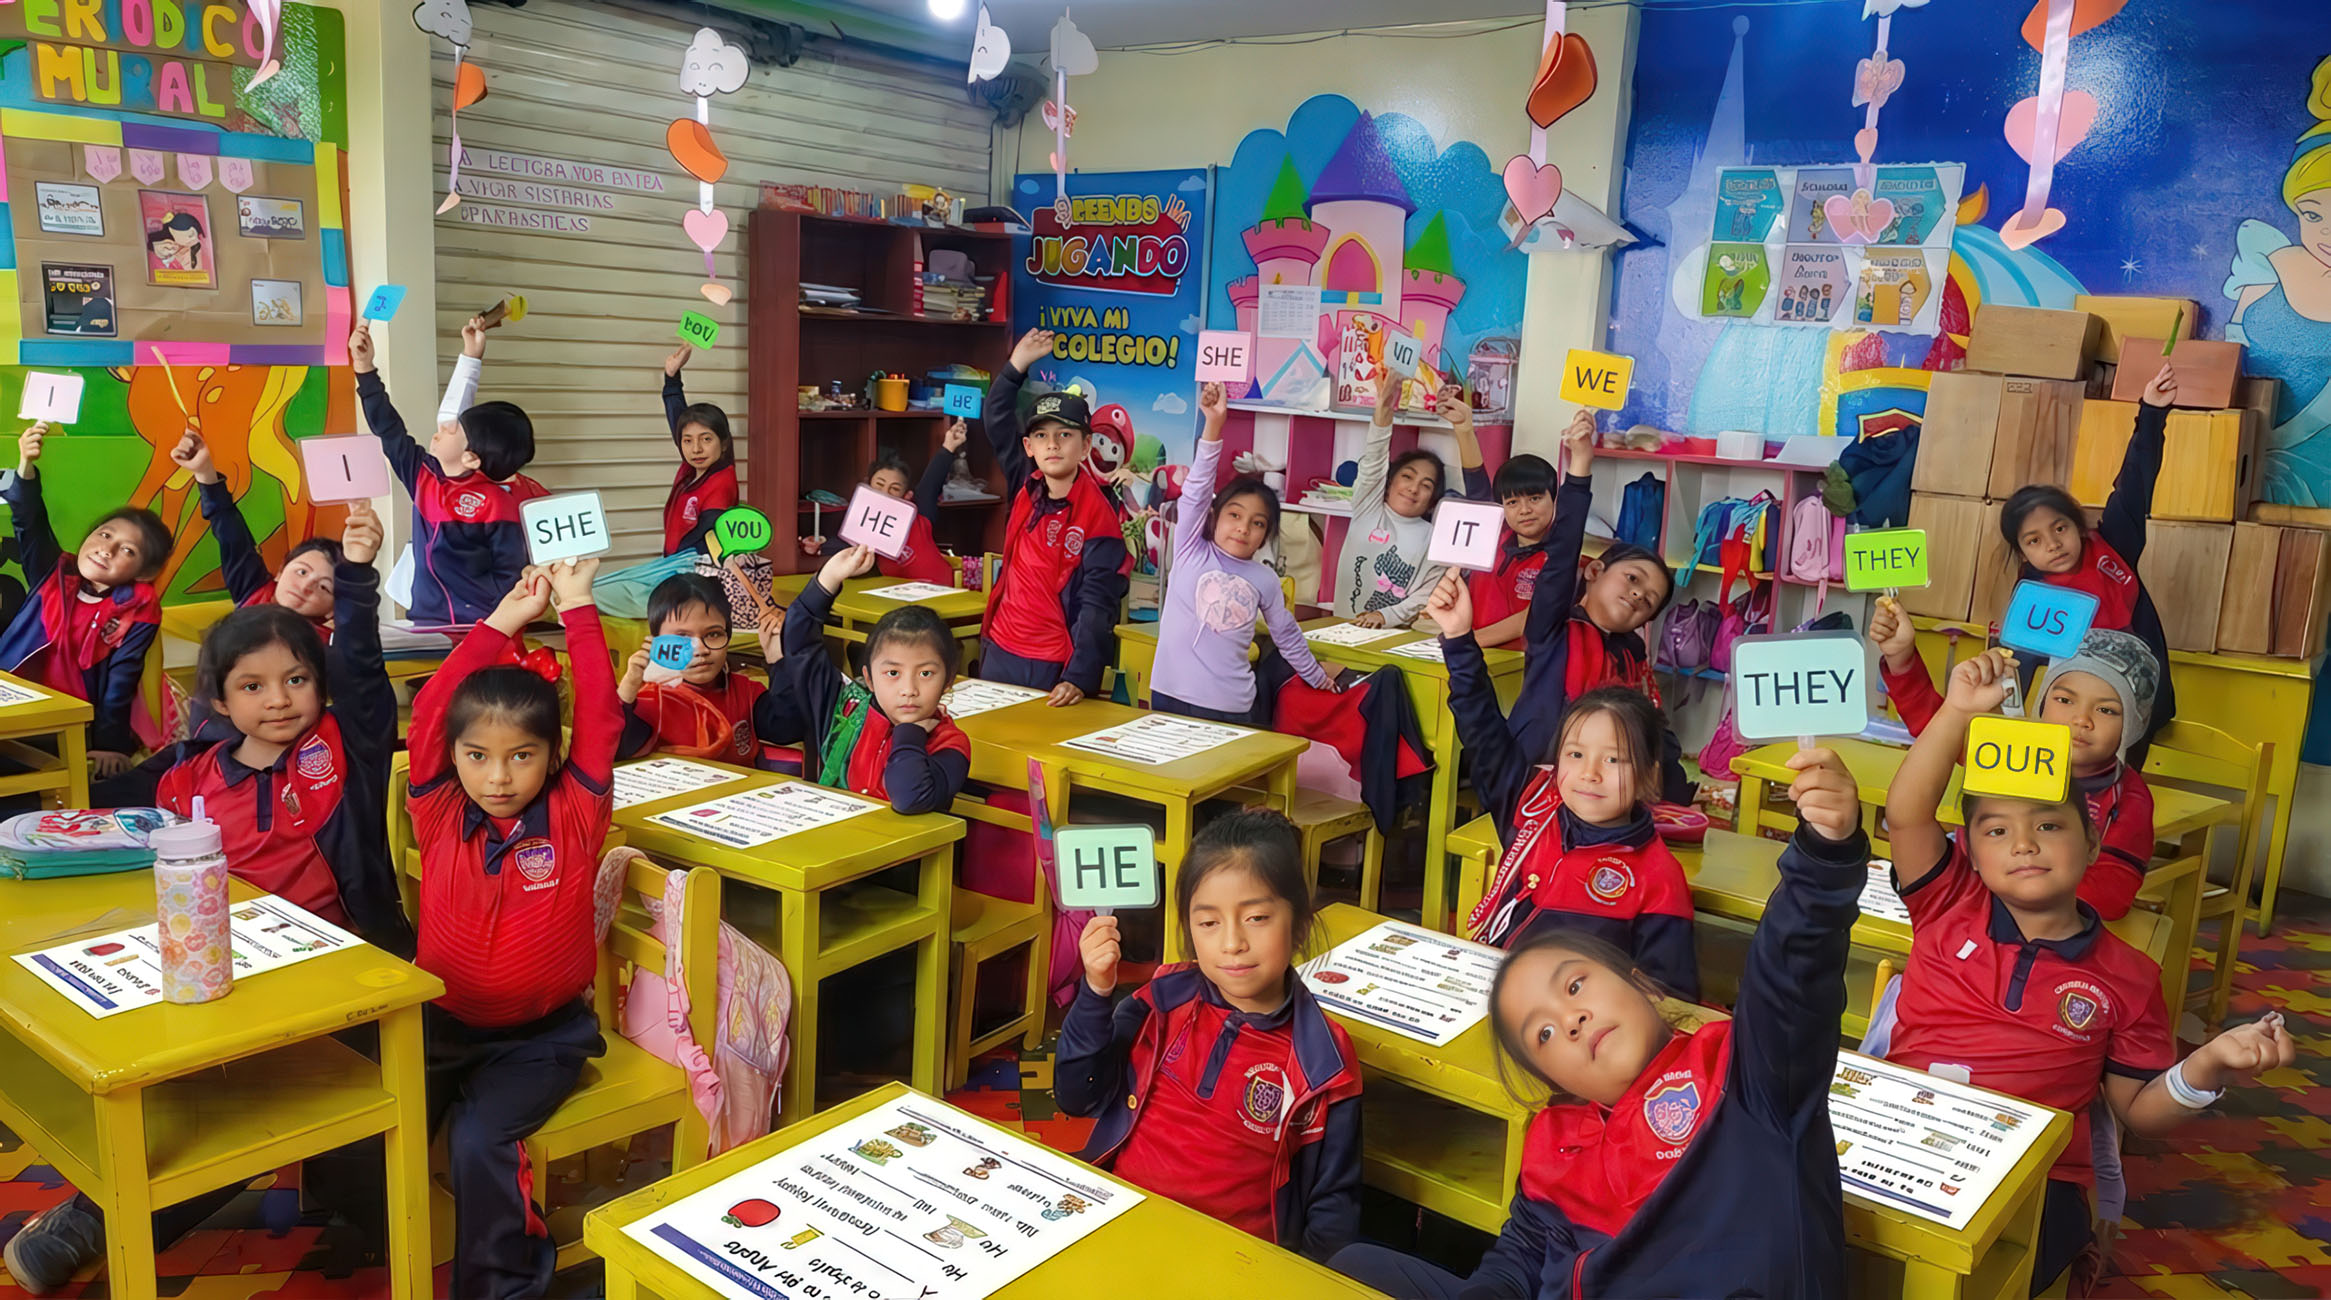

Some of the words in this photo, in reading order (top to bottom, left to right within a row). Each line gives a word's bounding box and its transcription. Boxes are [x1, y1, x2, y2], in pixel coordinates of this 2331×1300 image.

[0, 0, 279, 59] ERIODICO
[37, 43, 226, 118] MURAL
[1026, 234, 1190, 277] JUGANDO
[1103, 306, 1130, 330] MI
[1052, 332, 1181, 369] COLEGIO!
[1202, 346, 1243, 372] SHE
[1575, 366, 1619, 394] WE
[342, 454, 351, 482] I
[535, 511, 596, 545] SHE
[860, 506, 898, 537] HE
[1451, 520, 1480, 546] IT
[1853, 547, 1920, 574] THEY
[2027, 603, 2069, 635] US
[657, 643, 683, 660] HE
[1744, 669, 1855, 706] THEY
[1974, 741, 2056, 777] OUR
[1074, 846, 1140, 890] HE
